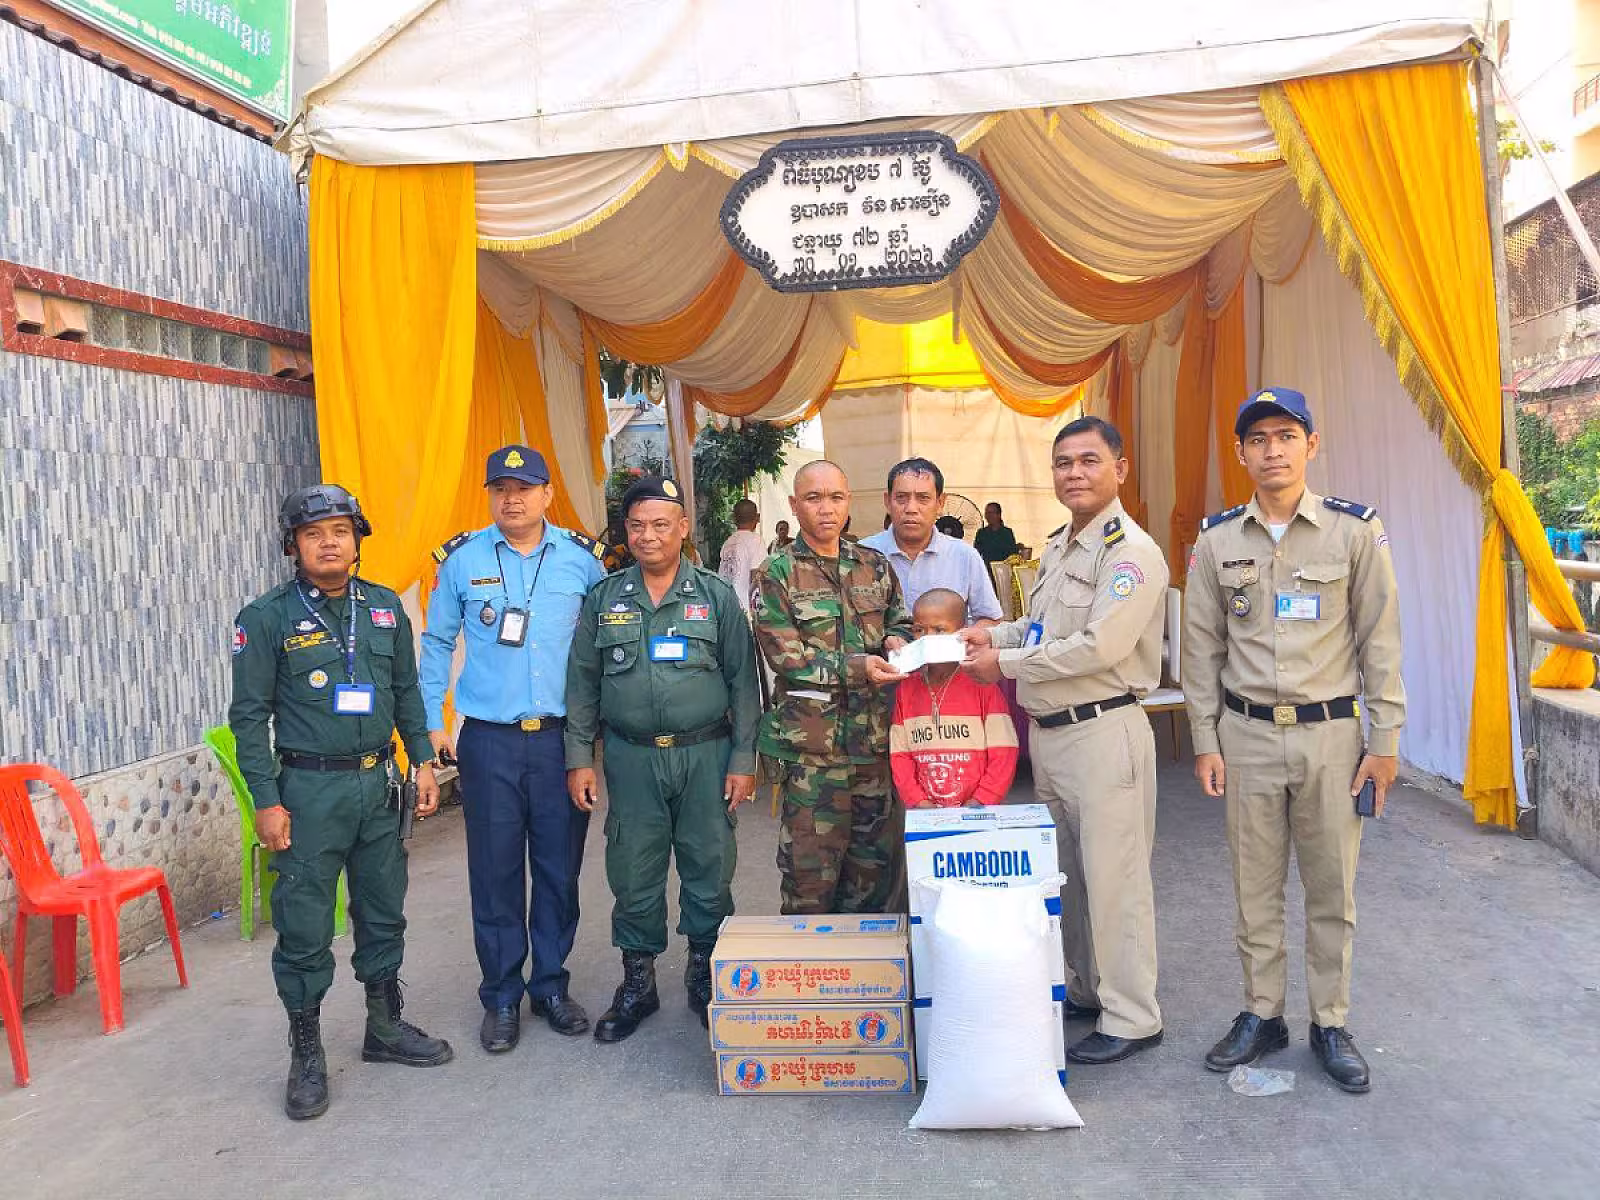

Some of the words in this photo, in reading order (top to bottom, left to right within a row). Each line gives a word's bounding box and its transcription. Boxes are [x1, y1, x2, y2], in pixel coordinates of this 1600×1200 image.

[889, 156, 902, 178] ៧
[852, 225, 880, 246] ៧២
[938, 723, 970, 740] TUNG
[933, 849, 1033, 879] CAMBODIA
